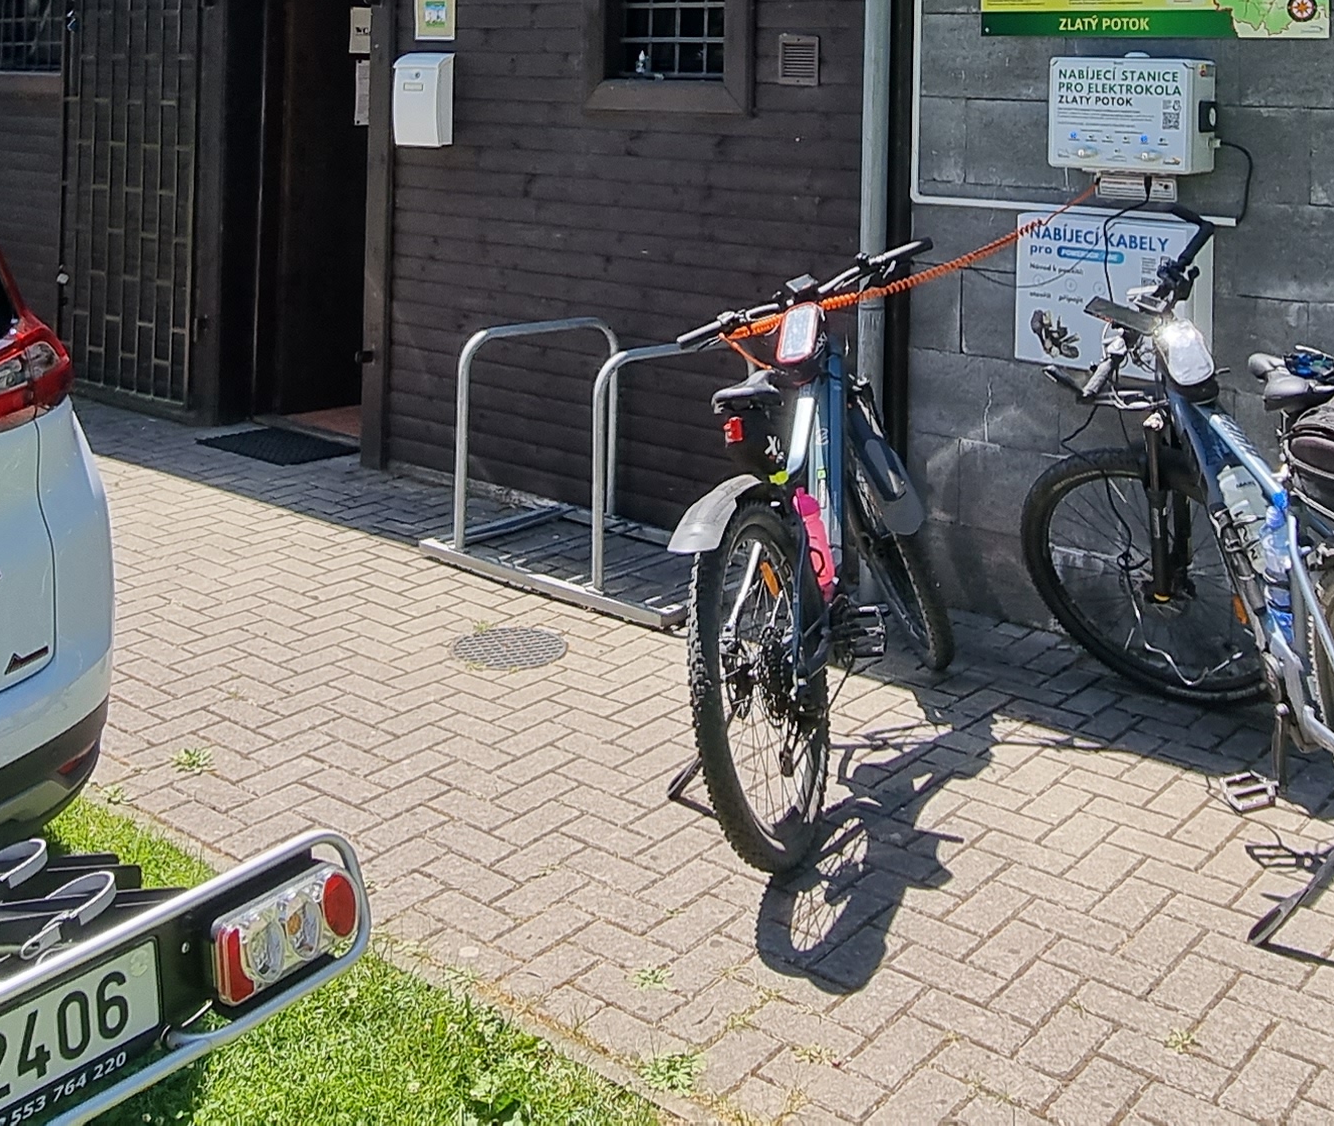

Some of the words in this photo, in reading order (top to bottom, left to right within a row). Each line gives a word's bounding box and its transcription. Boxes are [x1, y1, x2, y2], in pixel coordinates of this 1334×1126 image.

[1058, 15, 1099, 31] ZLATÝ
[1102, 17, 1150, 31] POTOK
[1059, 66, 1116, 80] NABÍJECÍ
[1121, 70, 1179, 82] STANICE
[1058, 81, 1084, 93] PRO
[1088, 83, 1182, 96] ELEKTROKOLA
[1058, 93, 1091, 105] ZLATÝ
[1095, 96, 1133, 106] POTOK
[1030, 224, 1100, 245] NABÍJECÍ
[1107, 231, 1169, 252] KABELY
[1030, 244, 1052, 255] pro
[10, 1095, 46, 1126] 553
[53, 1073, 87, 1102] 764
[93, 1051, 127, 1081] 220
